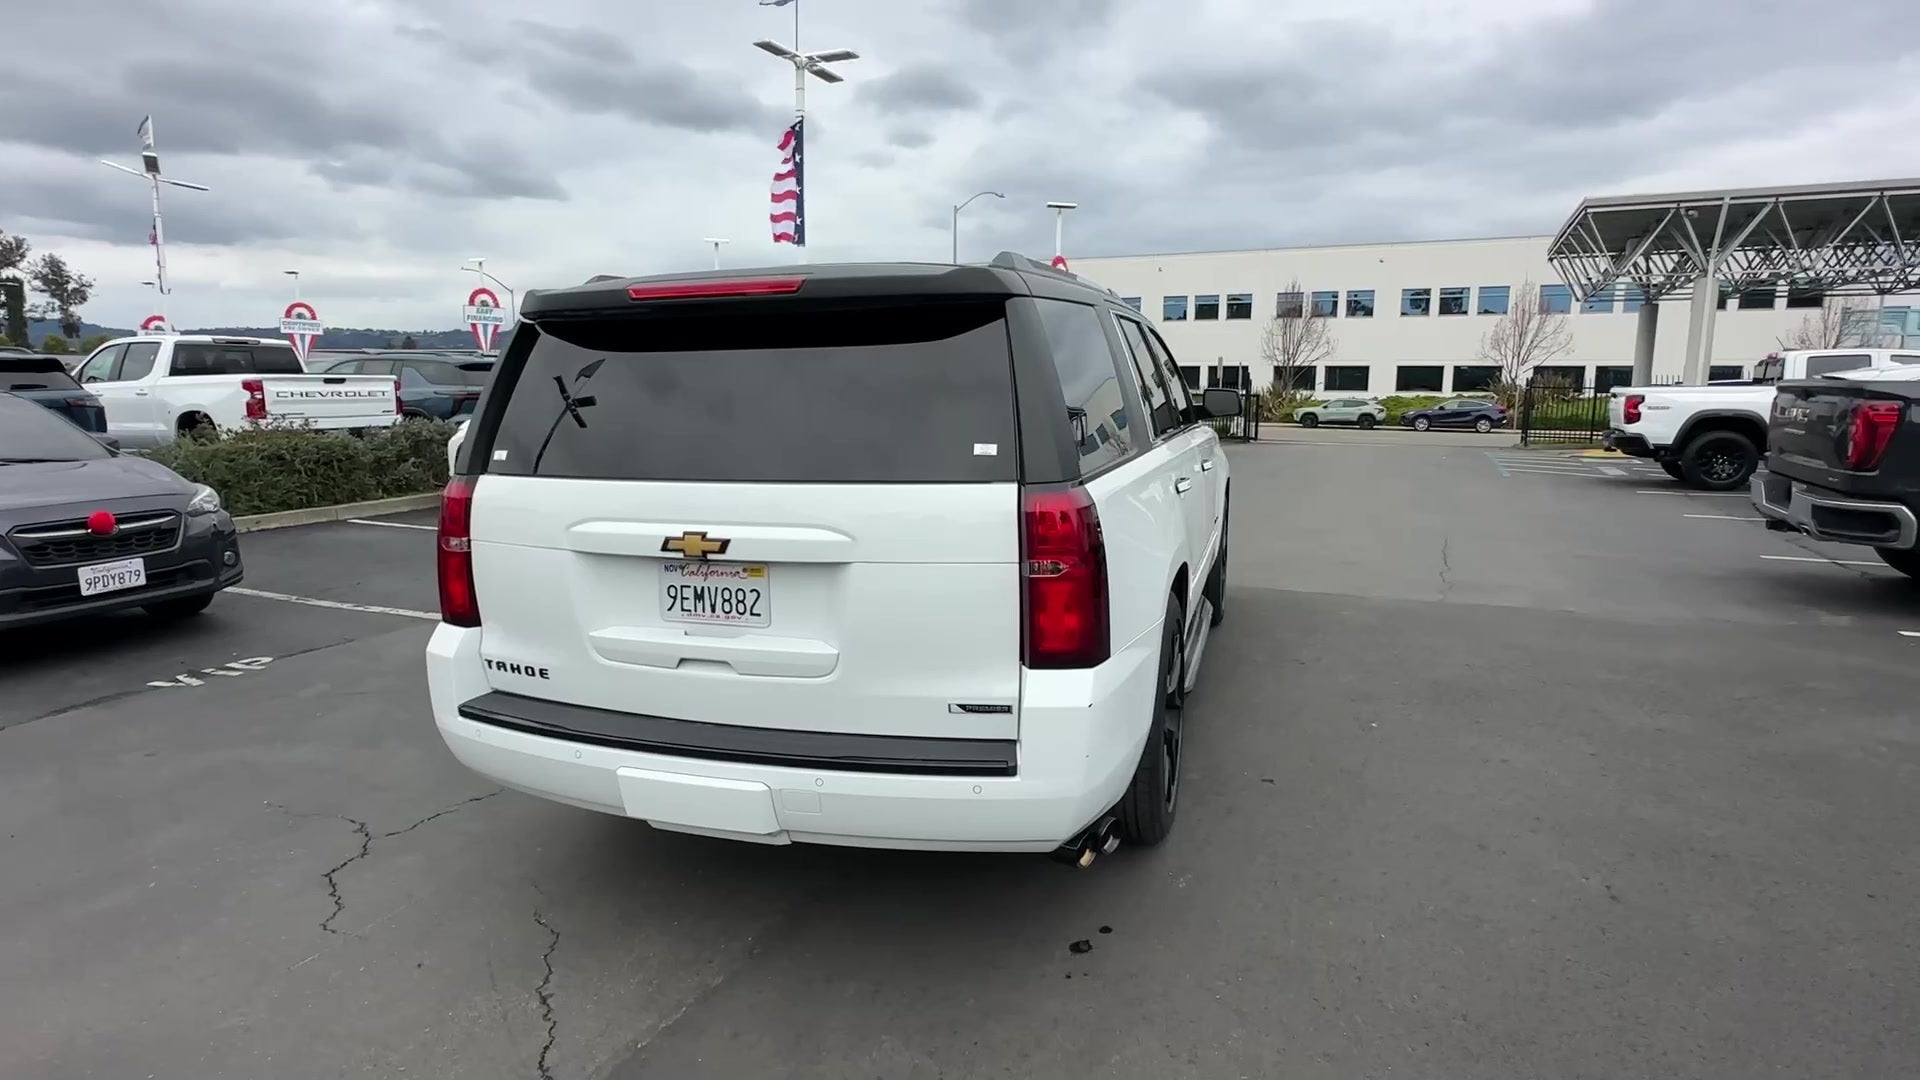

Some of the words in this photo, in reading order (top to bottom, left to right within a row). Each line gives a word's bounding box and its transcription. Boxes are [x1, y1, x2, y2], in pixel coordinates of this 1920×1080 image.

[275, 390, 389, 398] CHEVROLET
[84, 569, 141, 592] 9PDY879
[663, 564, 678, 573] NOV
[681, 563, 748, 582] California
[666, 584, 762, 617] 9EMV882
[484, 658, 550, 680] TAHOE
